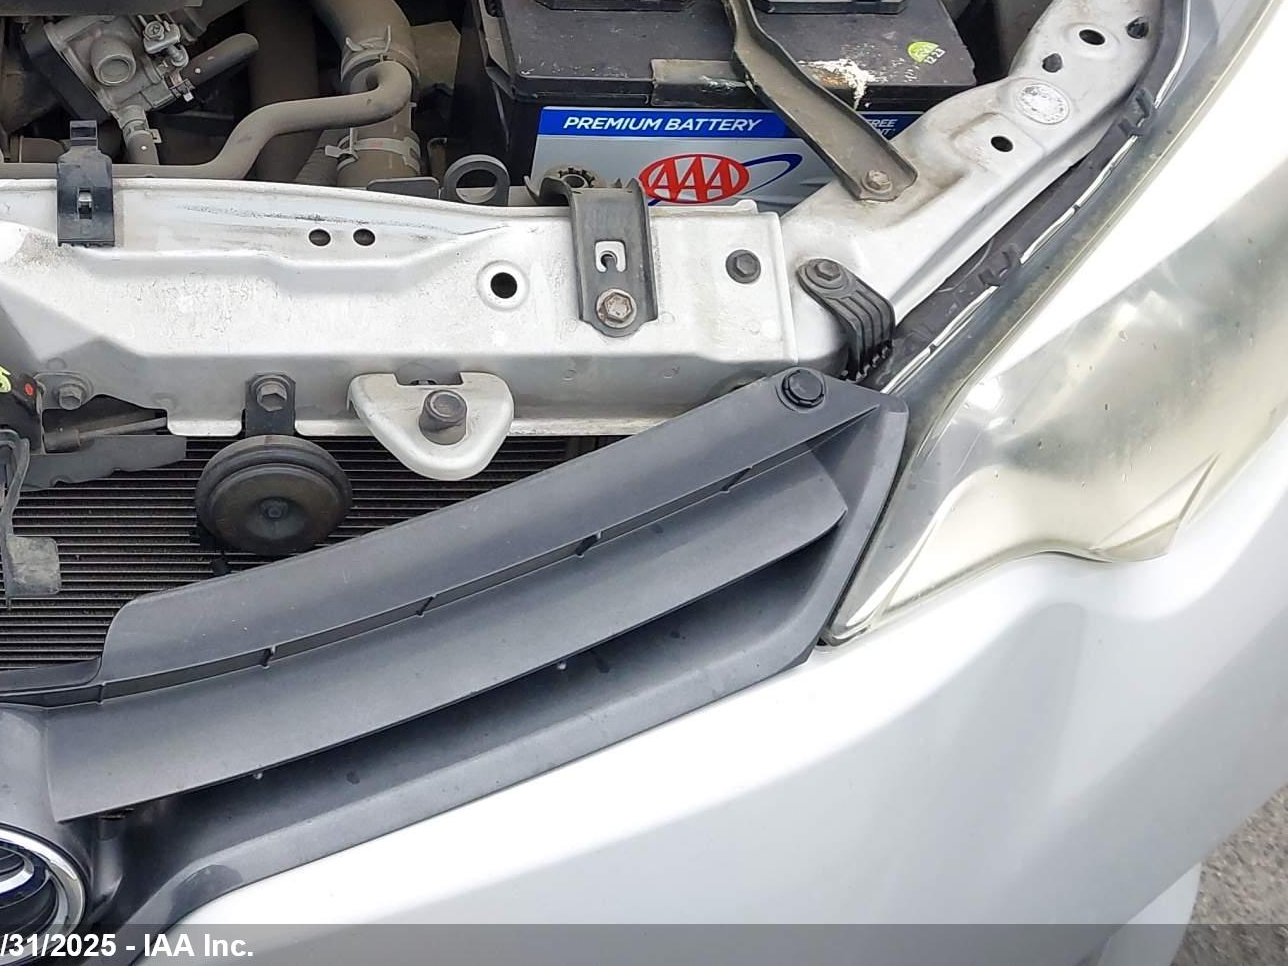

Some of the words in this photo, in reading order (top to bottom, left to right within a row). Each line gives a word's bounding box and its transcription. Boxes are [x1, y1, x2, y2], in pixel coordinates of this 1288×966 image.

[563, 117, 662, 130] PREMIUM
[664, 118, 762, 131] BATTERY
[646, 156, 743, 202] AAA
